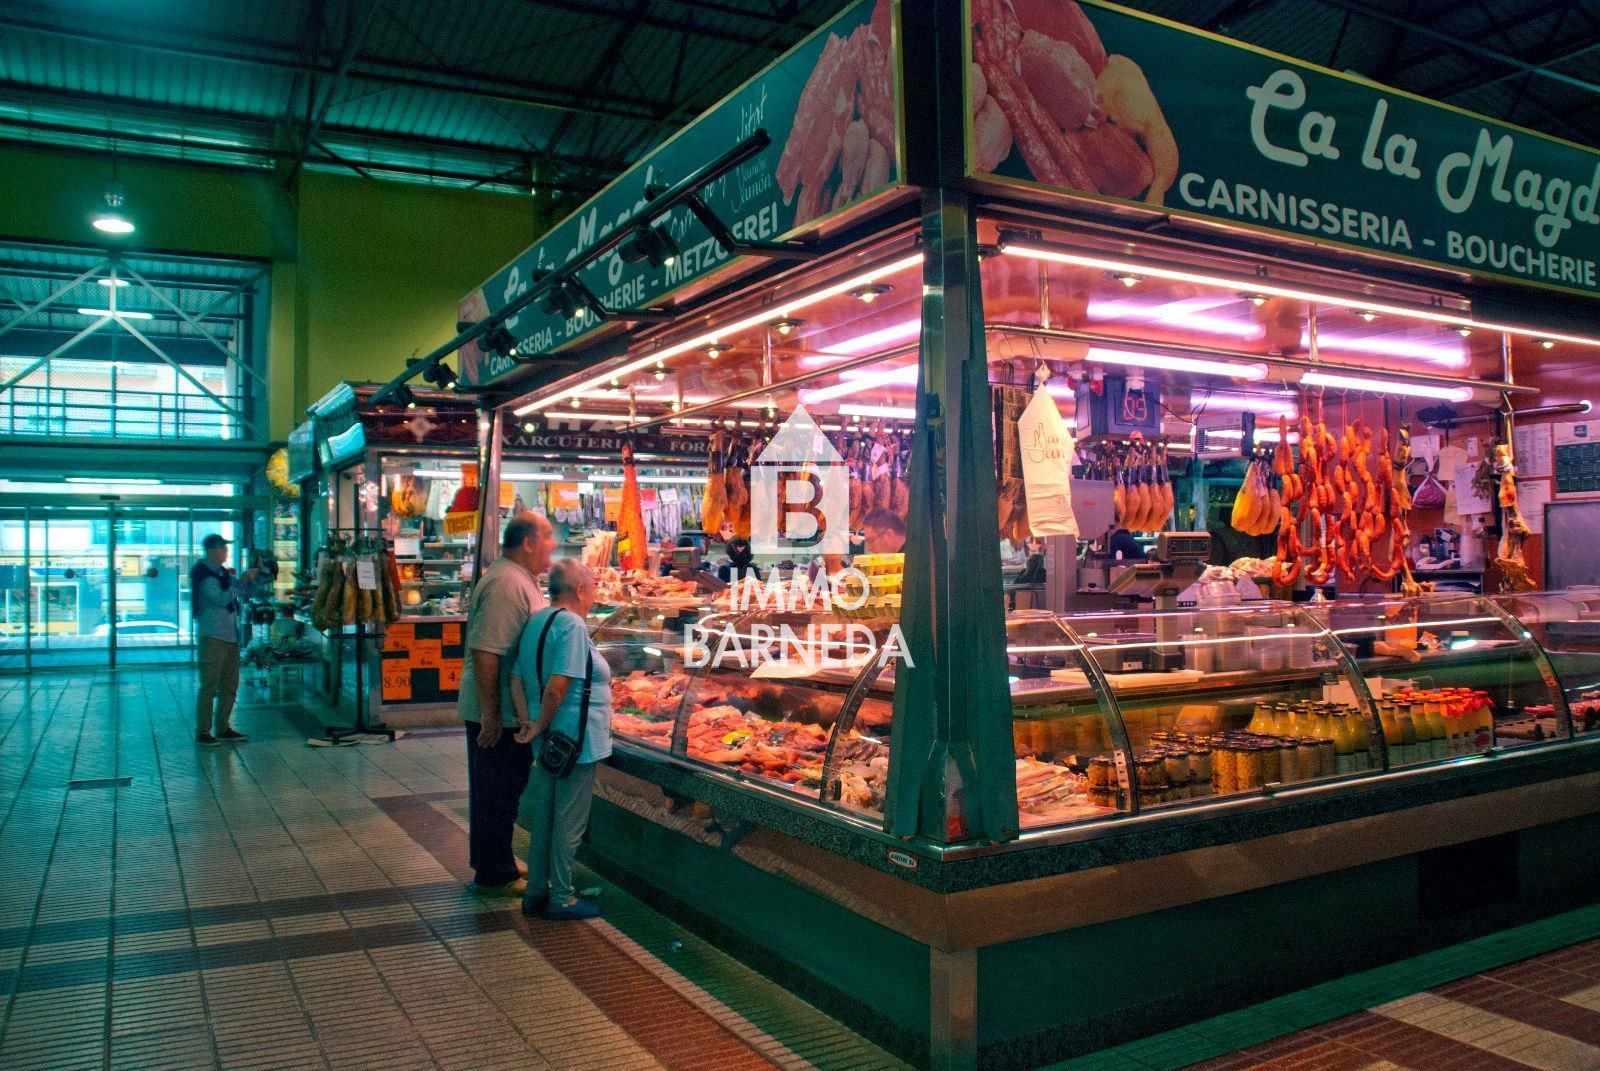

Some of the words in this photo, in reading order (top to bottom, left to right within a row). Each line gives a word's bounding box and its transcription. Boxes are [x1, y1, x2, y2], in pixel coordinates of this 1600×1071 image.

[1246, 69, 1340, 167] Ca
[1361, 98, 1421, 179] la
[1179, 172, 1412, 249] CARNISSERIA
[1447, 230, 1597, 287] BOUCHERIE
